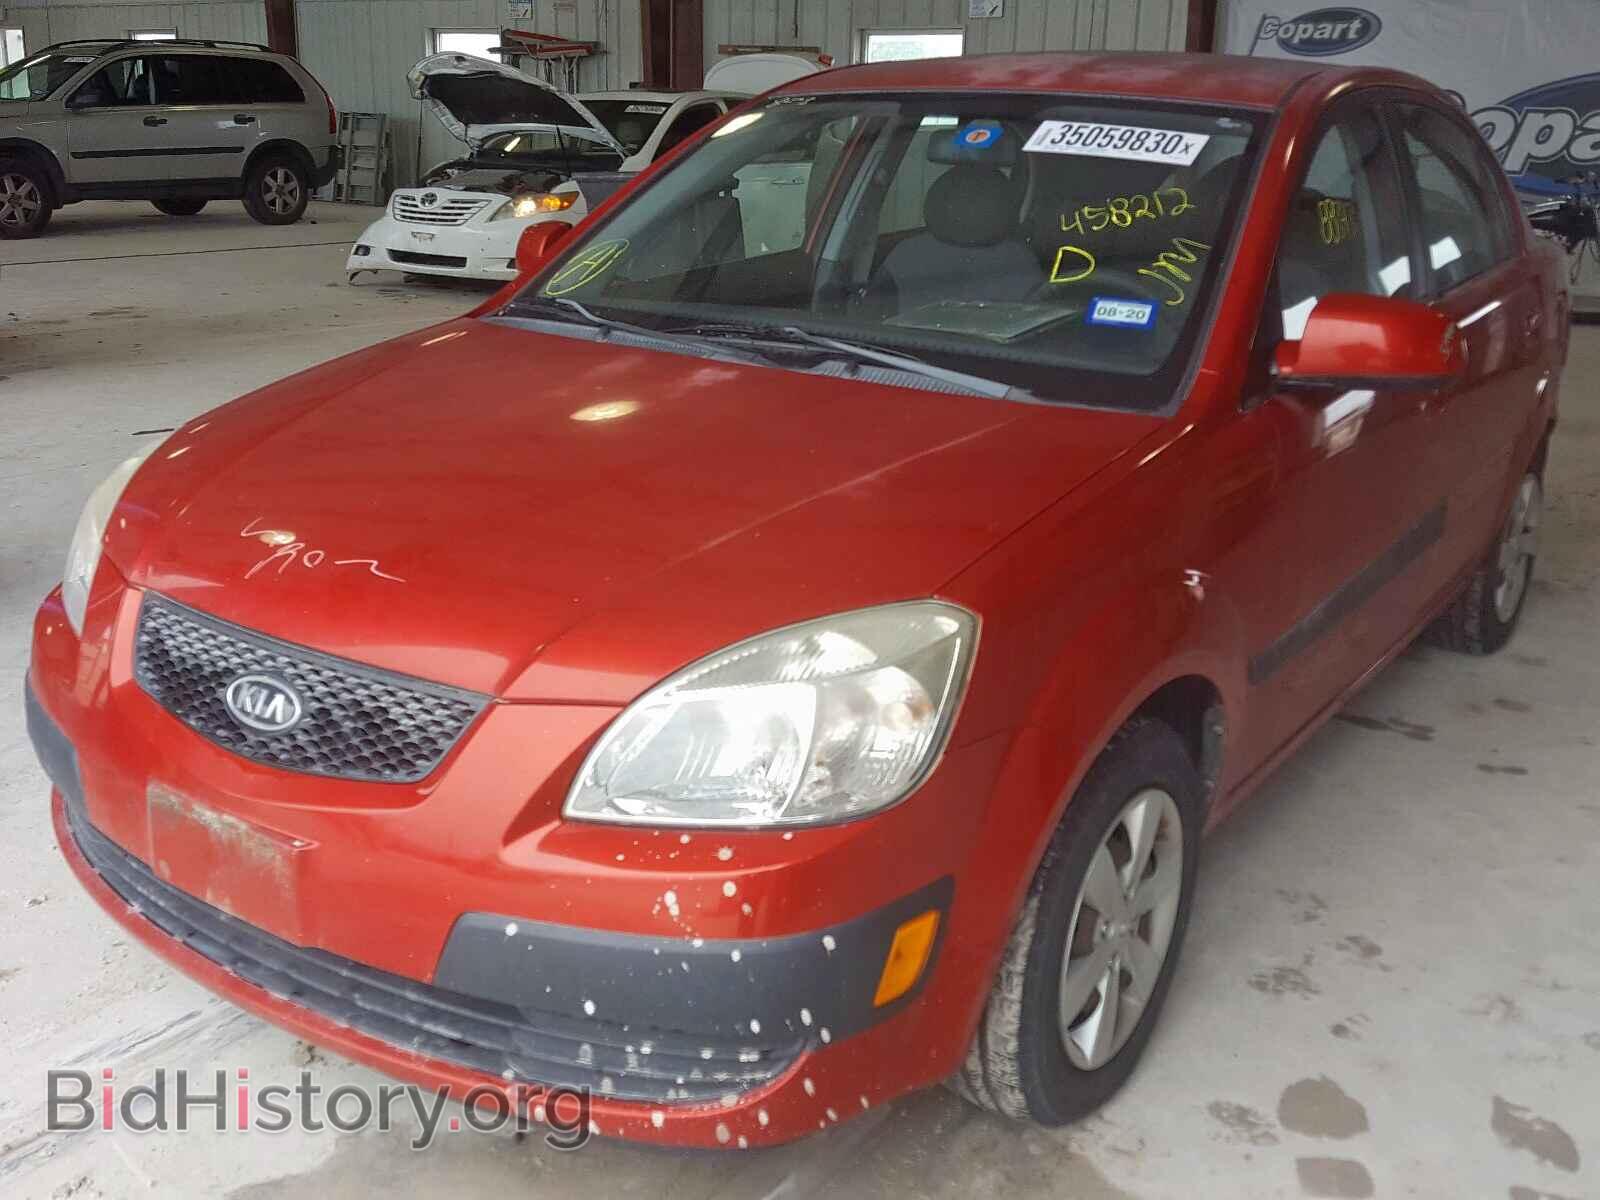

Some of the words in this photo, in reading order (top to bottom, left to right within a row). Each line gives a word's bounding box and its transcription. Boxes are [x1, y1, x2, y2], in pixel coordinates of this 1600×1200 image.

[1258, 15, 1362, 43] Copart
[1051, 124, 1184, 155] 35059830
[1050, 246, 1096, 283] D
[1097, 306, 1147, 320] 08-20
[236, 682, 286, 724] KIA
